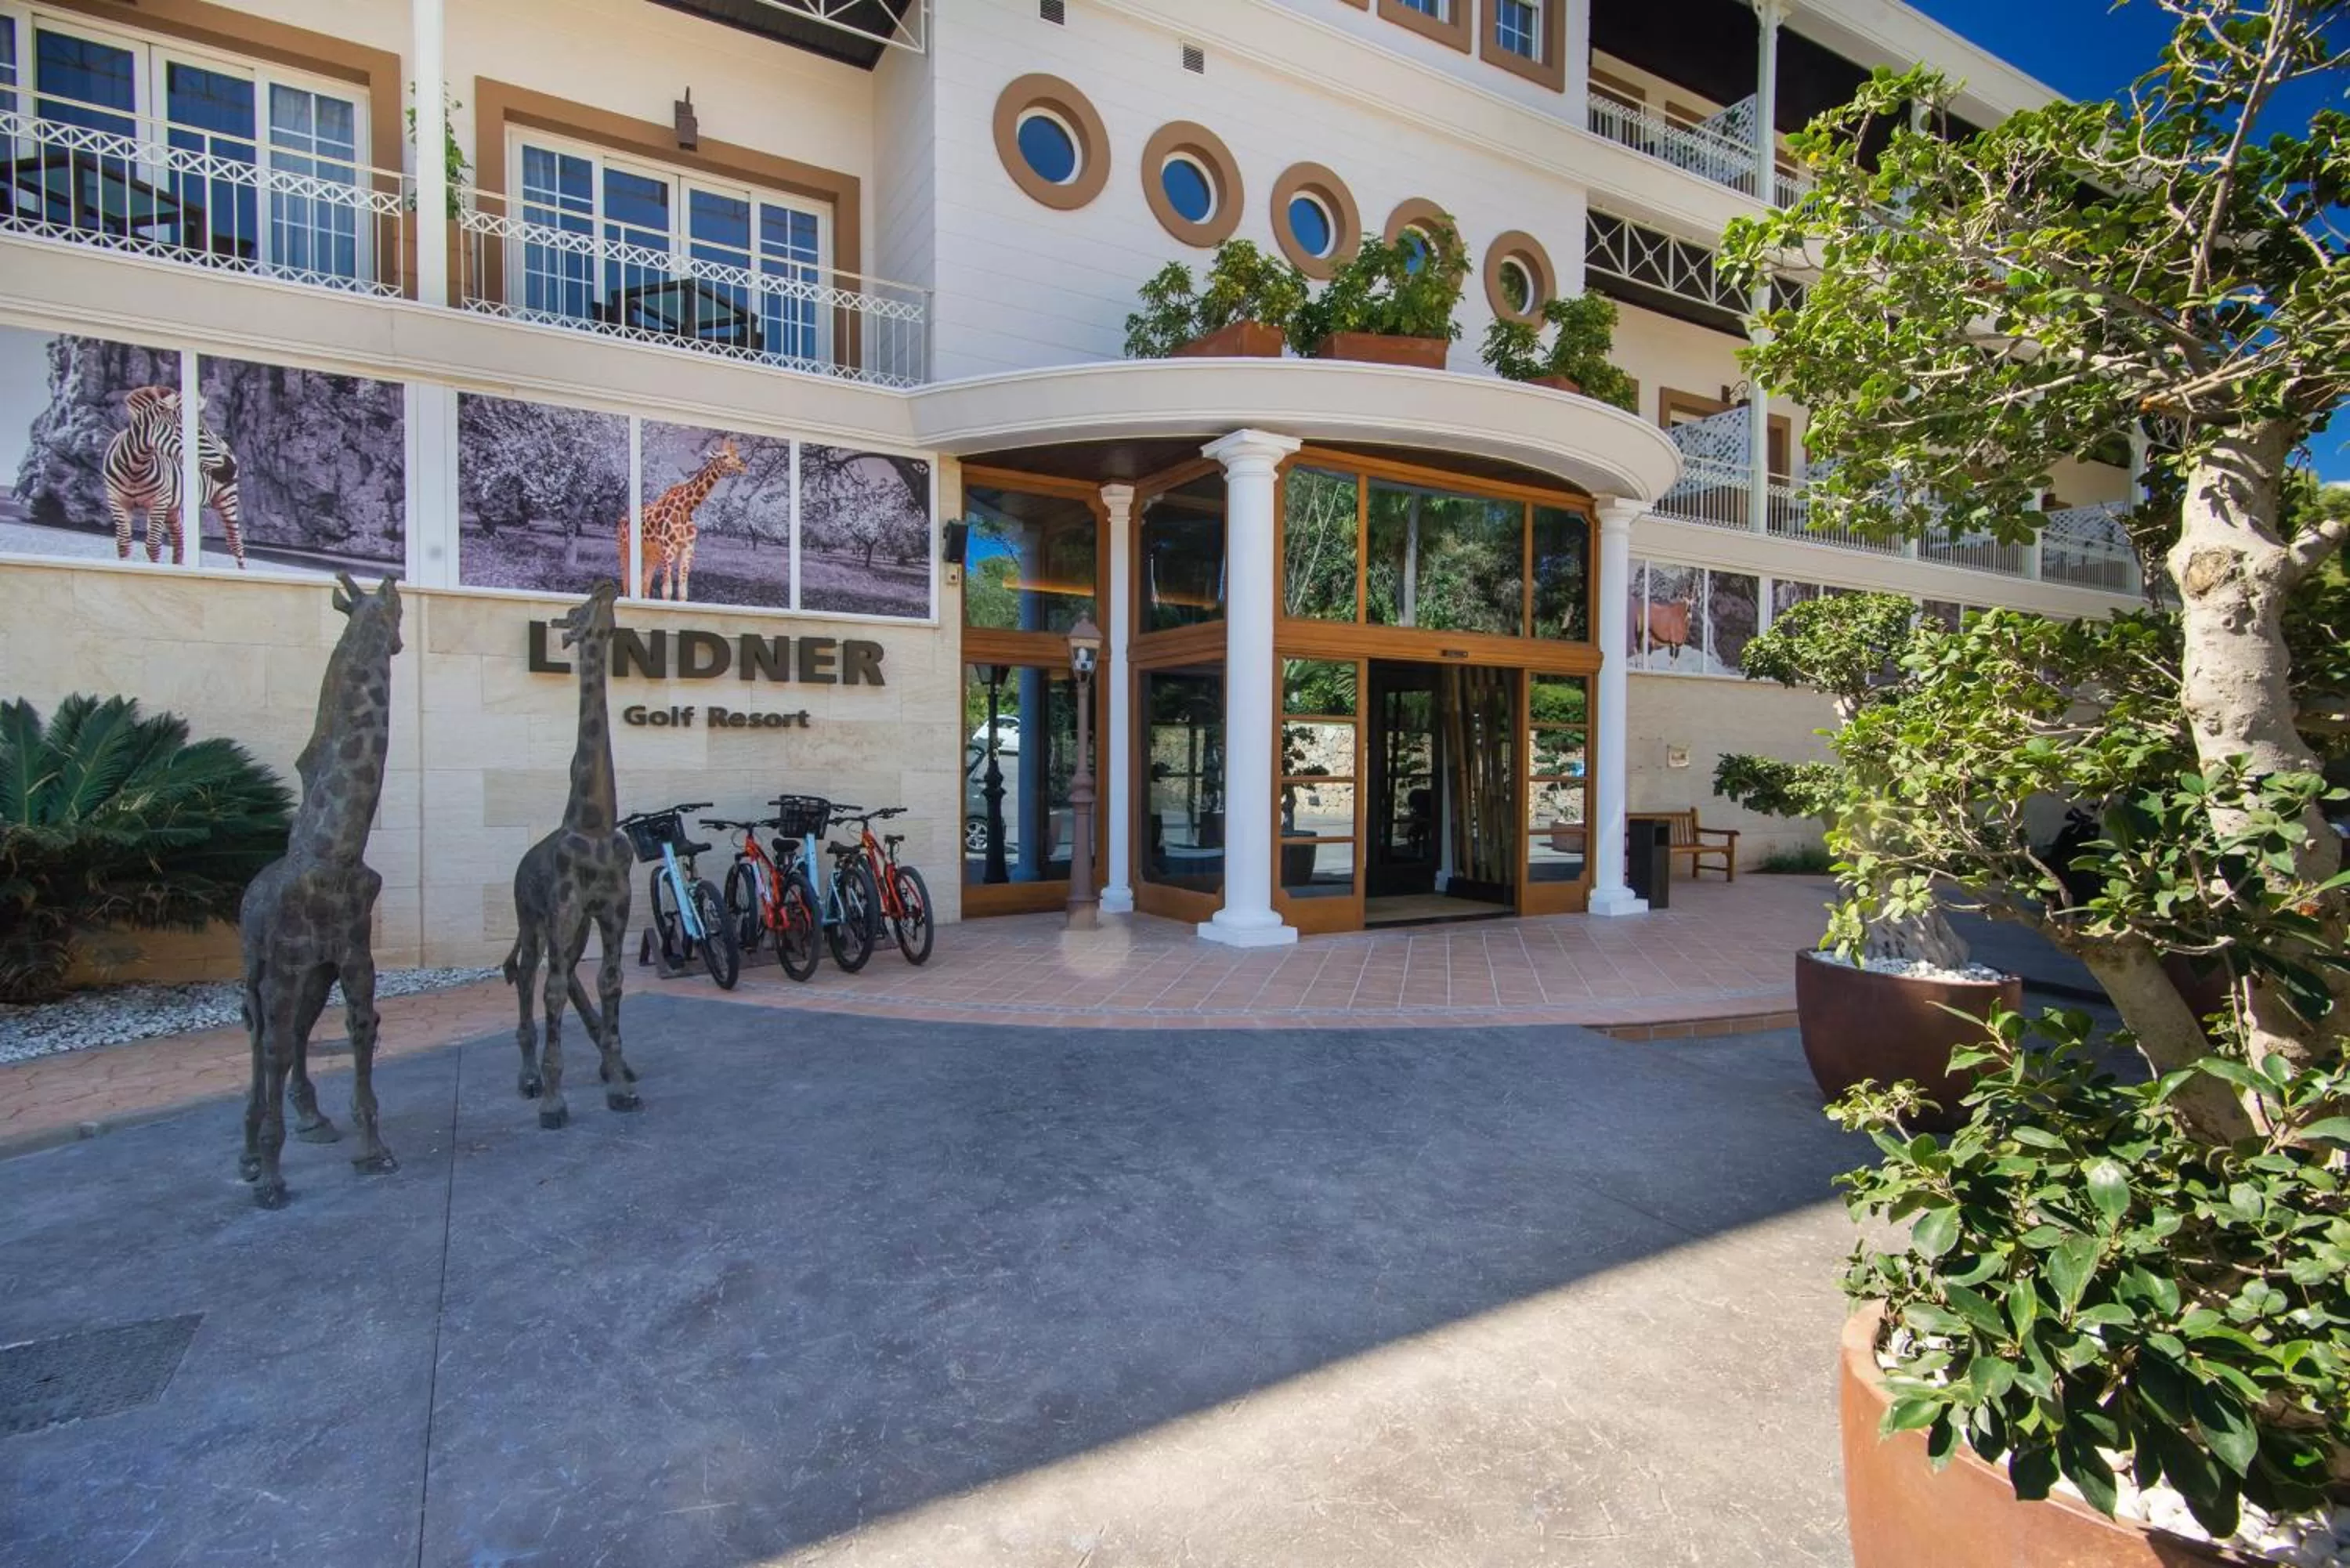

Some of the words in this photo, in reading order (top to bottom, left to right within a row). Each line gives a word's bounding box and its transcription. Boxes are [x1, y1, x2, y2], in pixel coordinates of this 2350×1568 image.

[529, 620, 885, 686] LNDNER
[624, 706, 695, 728] Golf
[707, 706, 810, 728] Resort
